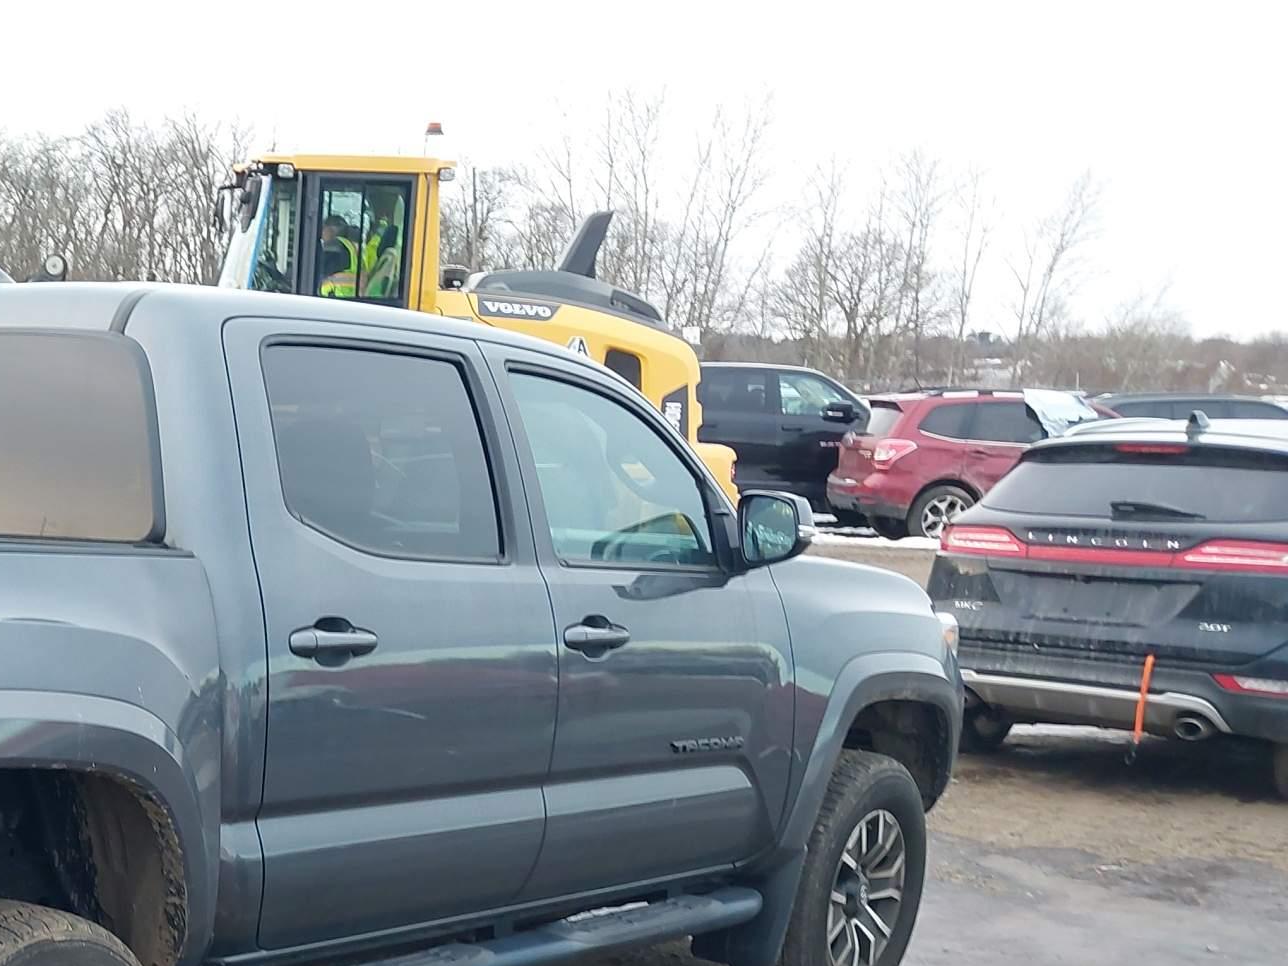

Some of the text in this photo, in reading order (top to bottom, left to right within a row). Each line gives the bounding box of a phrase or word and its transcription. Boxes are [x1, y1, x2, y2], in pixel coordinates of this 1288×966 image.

[482, 301, 552, 318] VOLVO
[1027, 531, 1180, 550] LINCOLN
[671, 736, 746, 753] TACOMA
